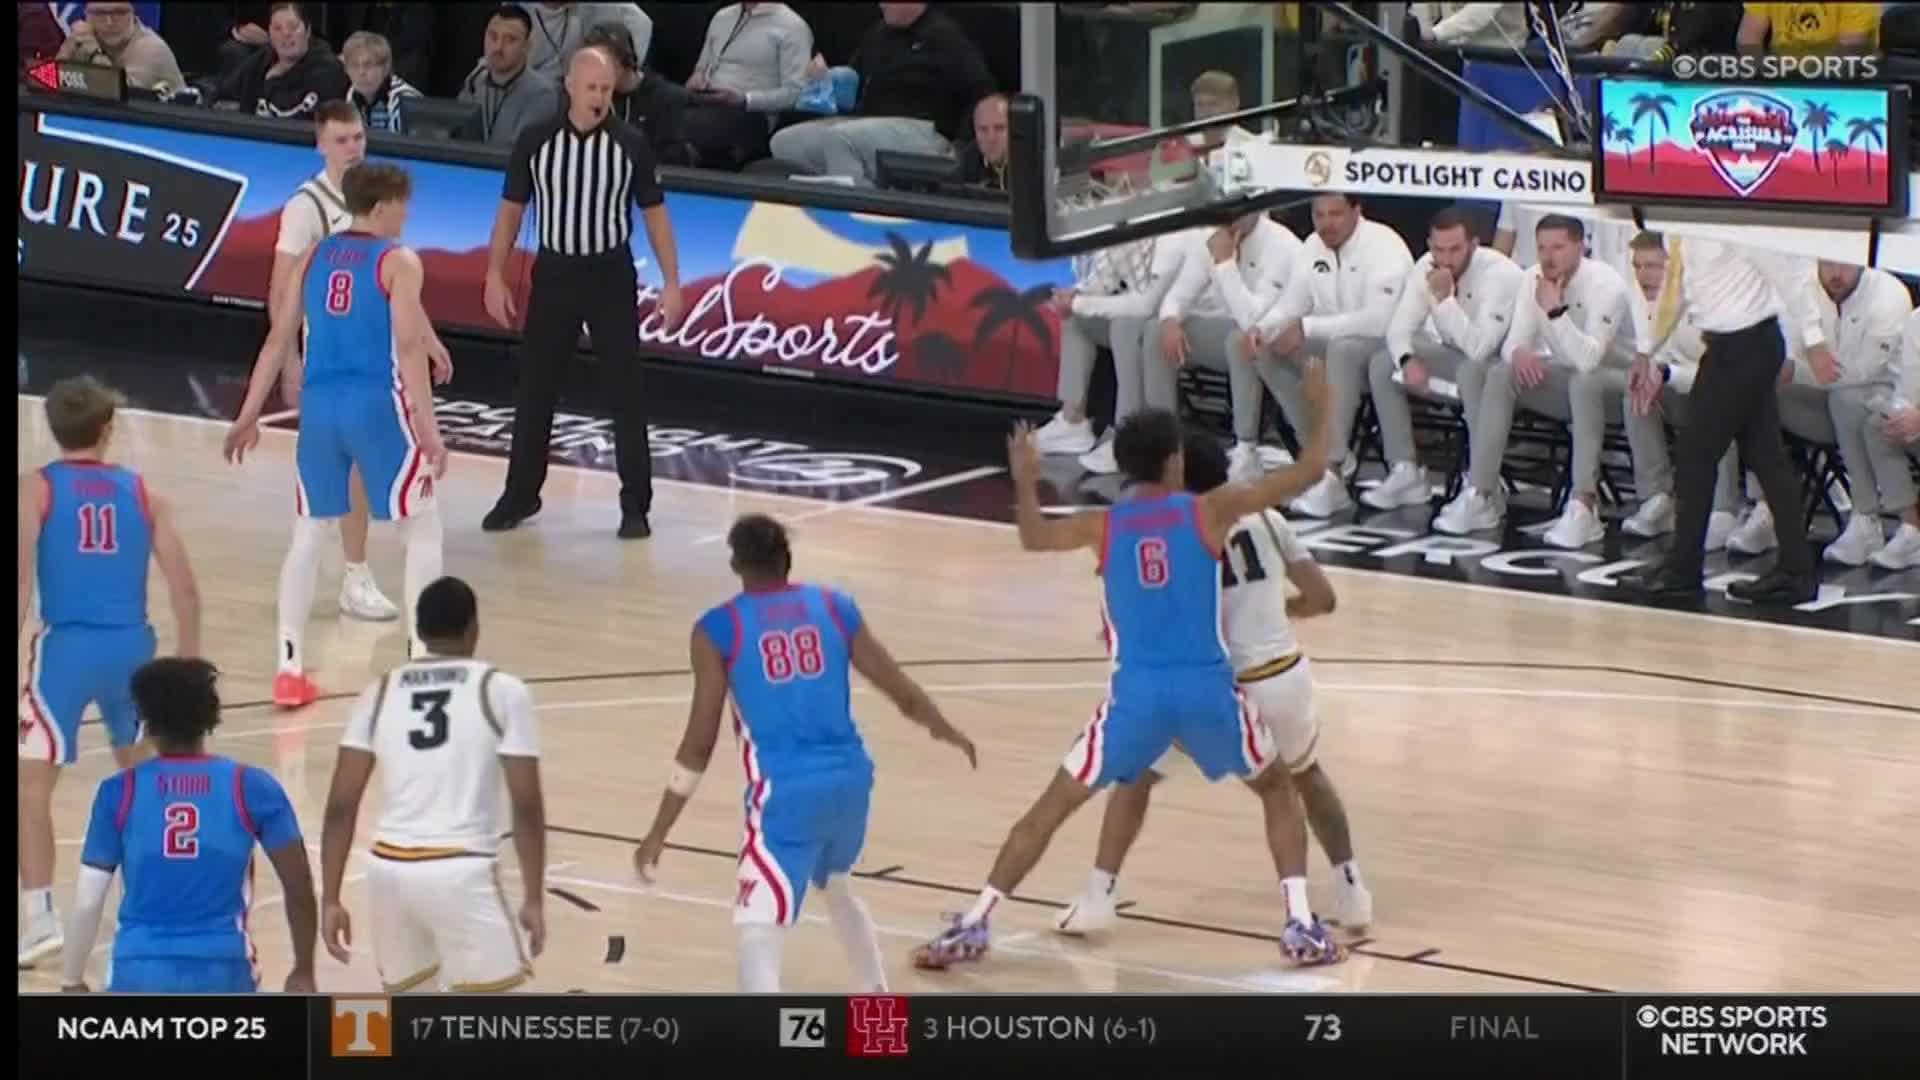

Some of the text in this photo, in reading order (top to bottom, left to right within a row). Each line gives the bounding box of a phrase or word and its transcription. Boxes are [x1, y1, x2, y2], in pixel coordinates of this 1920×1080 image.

[1345, 161, 1586, 193] SPOTLIGHT CASINO
[161, 212, 200, 248] 25
[326, 269, 353, 316] 8
[78, 502, 119, 554] 11
[1136, 536, 1169, 590] 6
[758, 624, 825, 684] 88
[408, 688, 452, 752] 3
[163, 801, 199, 859] 2
